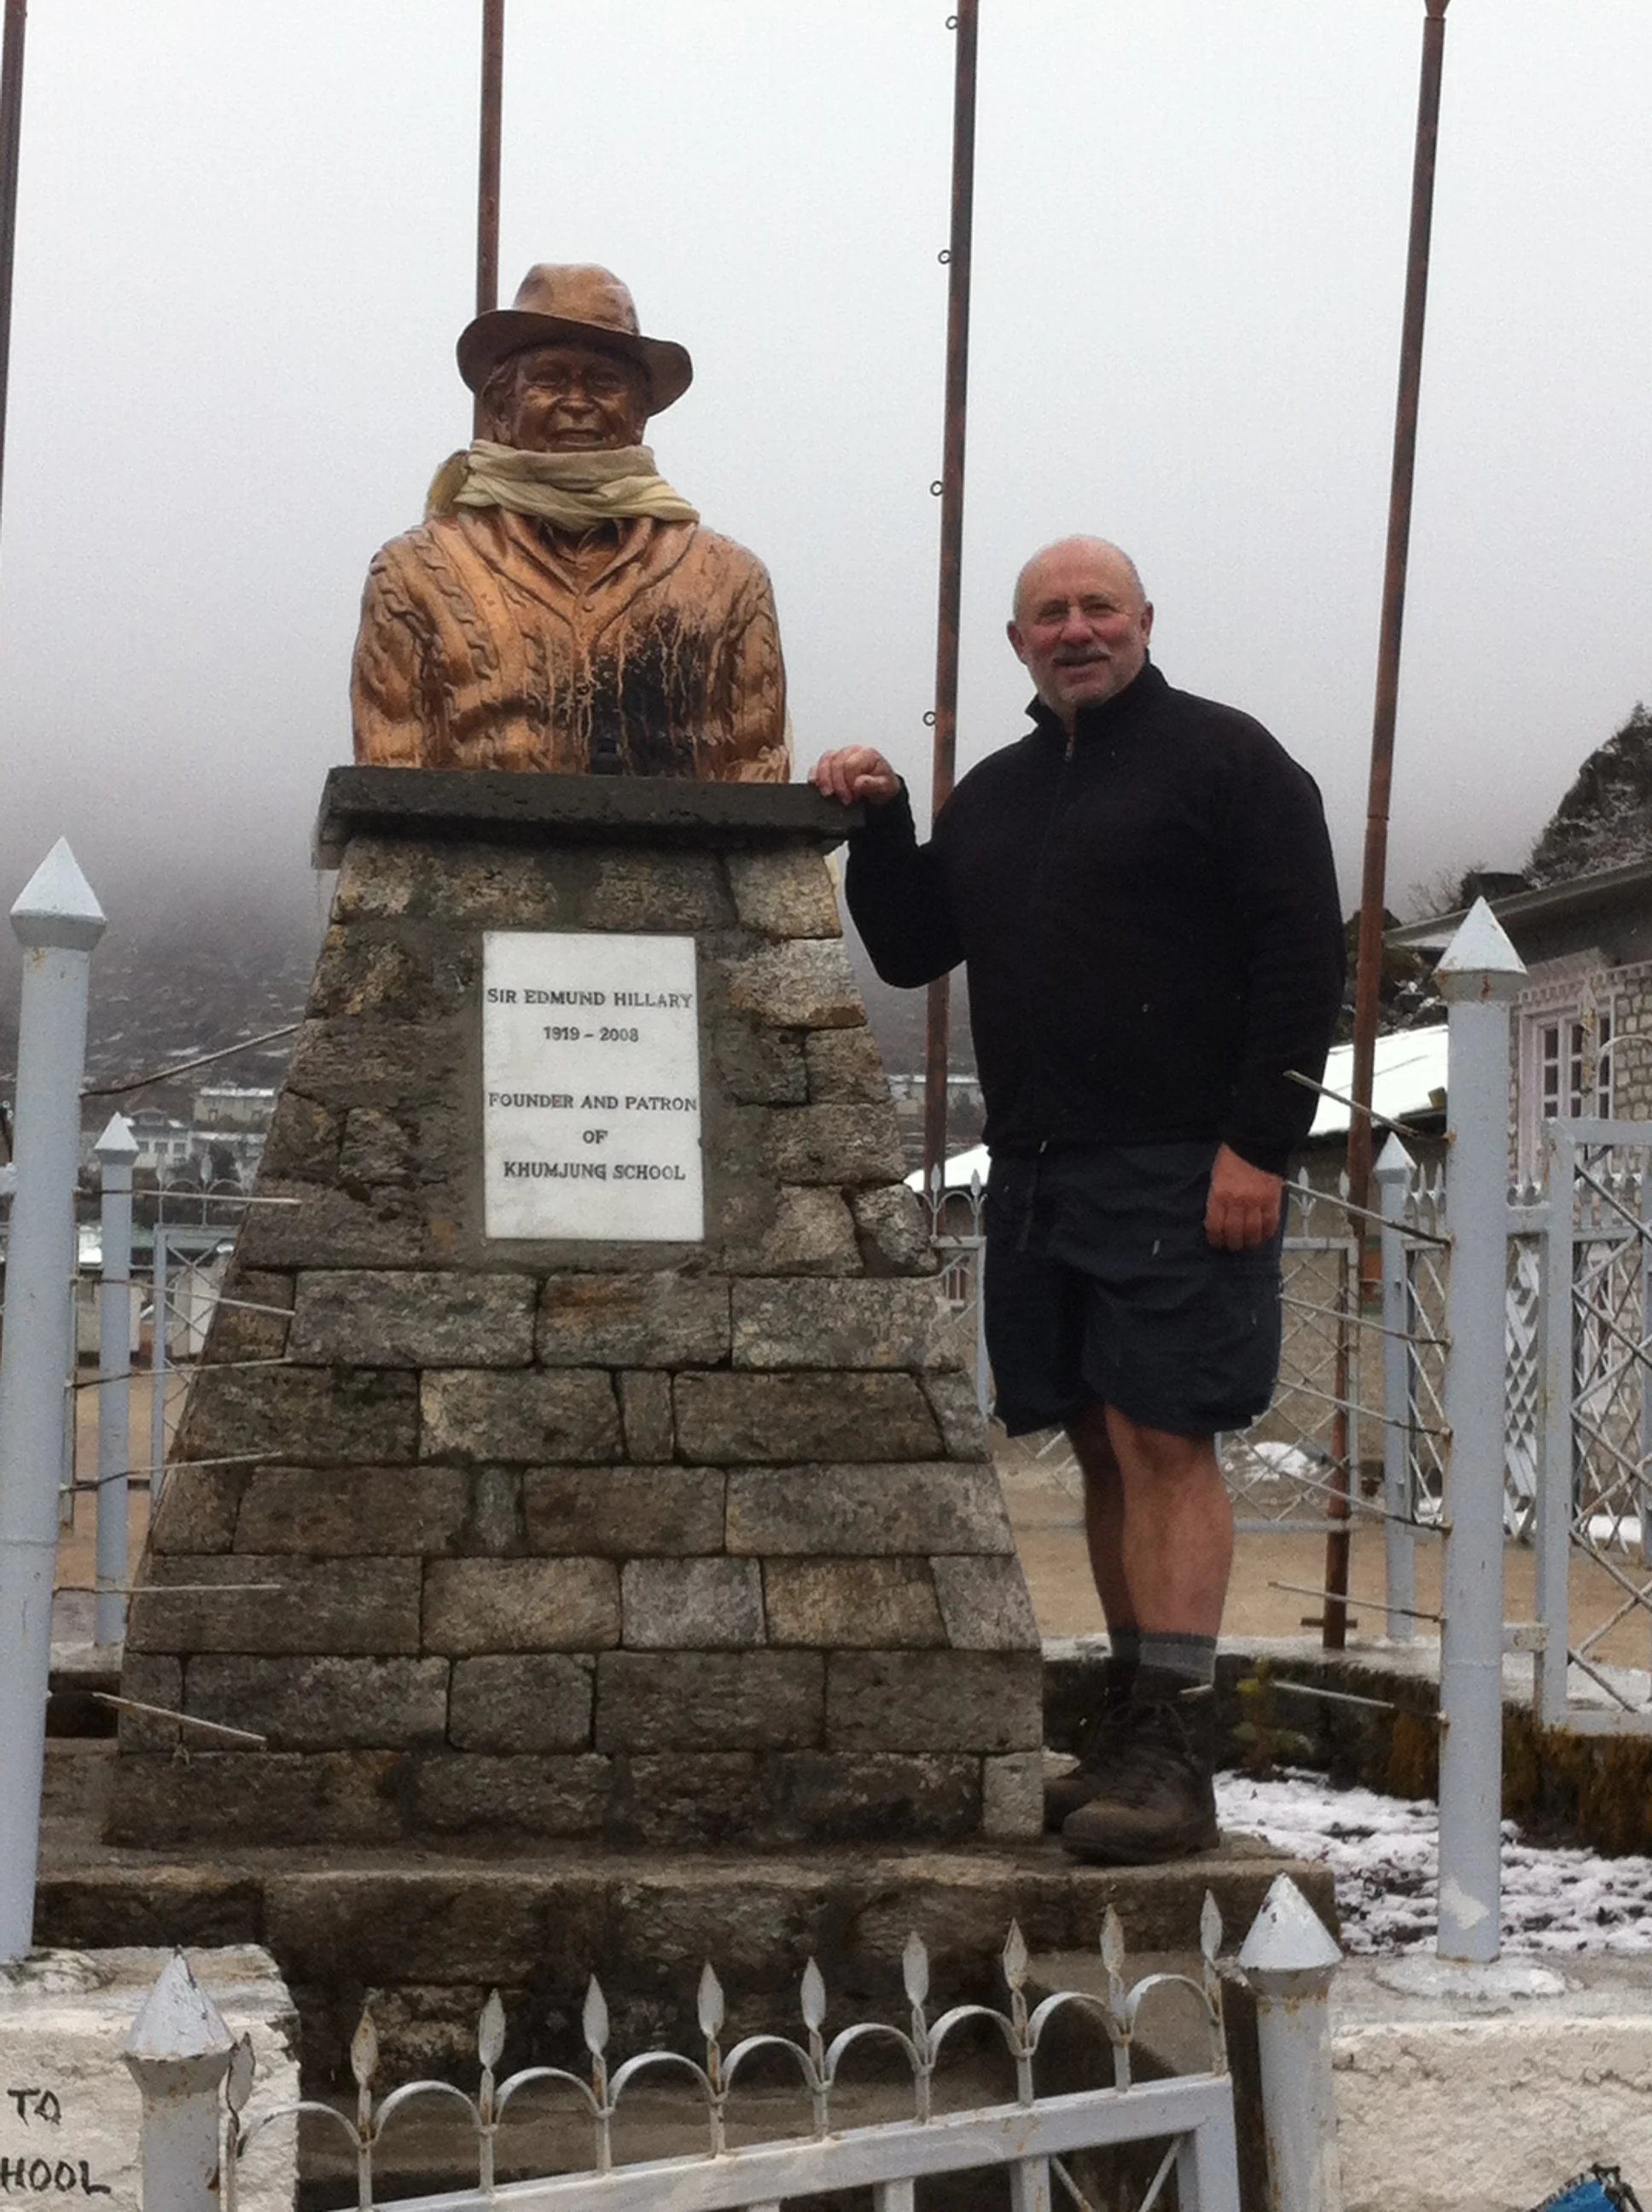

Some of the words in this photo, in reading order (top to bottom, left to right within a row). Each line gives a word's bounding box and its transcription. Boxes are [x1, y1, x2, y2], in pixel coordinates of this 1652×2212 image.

[487, 987, 517, 1005] SIR
[523, 989, 606, 1006] EDMUND
[614, 992, 693, 1010] HILLARY
[544, 1026, 580, 1040] 1919
[599, 1027, 640, 1042] 2008
[489, 1092, 574, 1109] FOUNDER
[581, 1095, 619, 1109] AND
[625, 1097, 697, 1111] PATRON
[582, 1130, 609, 1144] OF
[503, 1161, 607, 1180] KHUMJUNG
[612, 1165, 686, 1181] SCHOOL
[7, 2089, 62, 2126] TO
